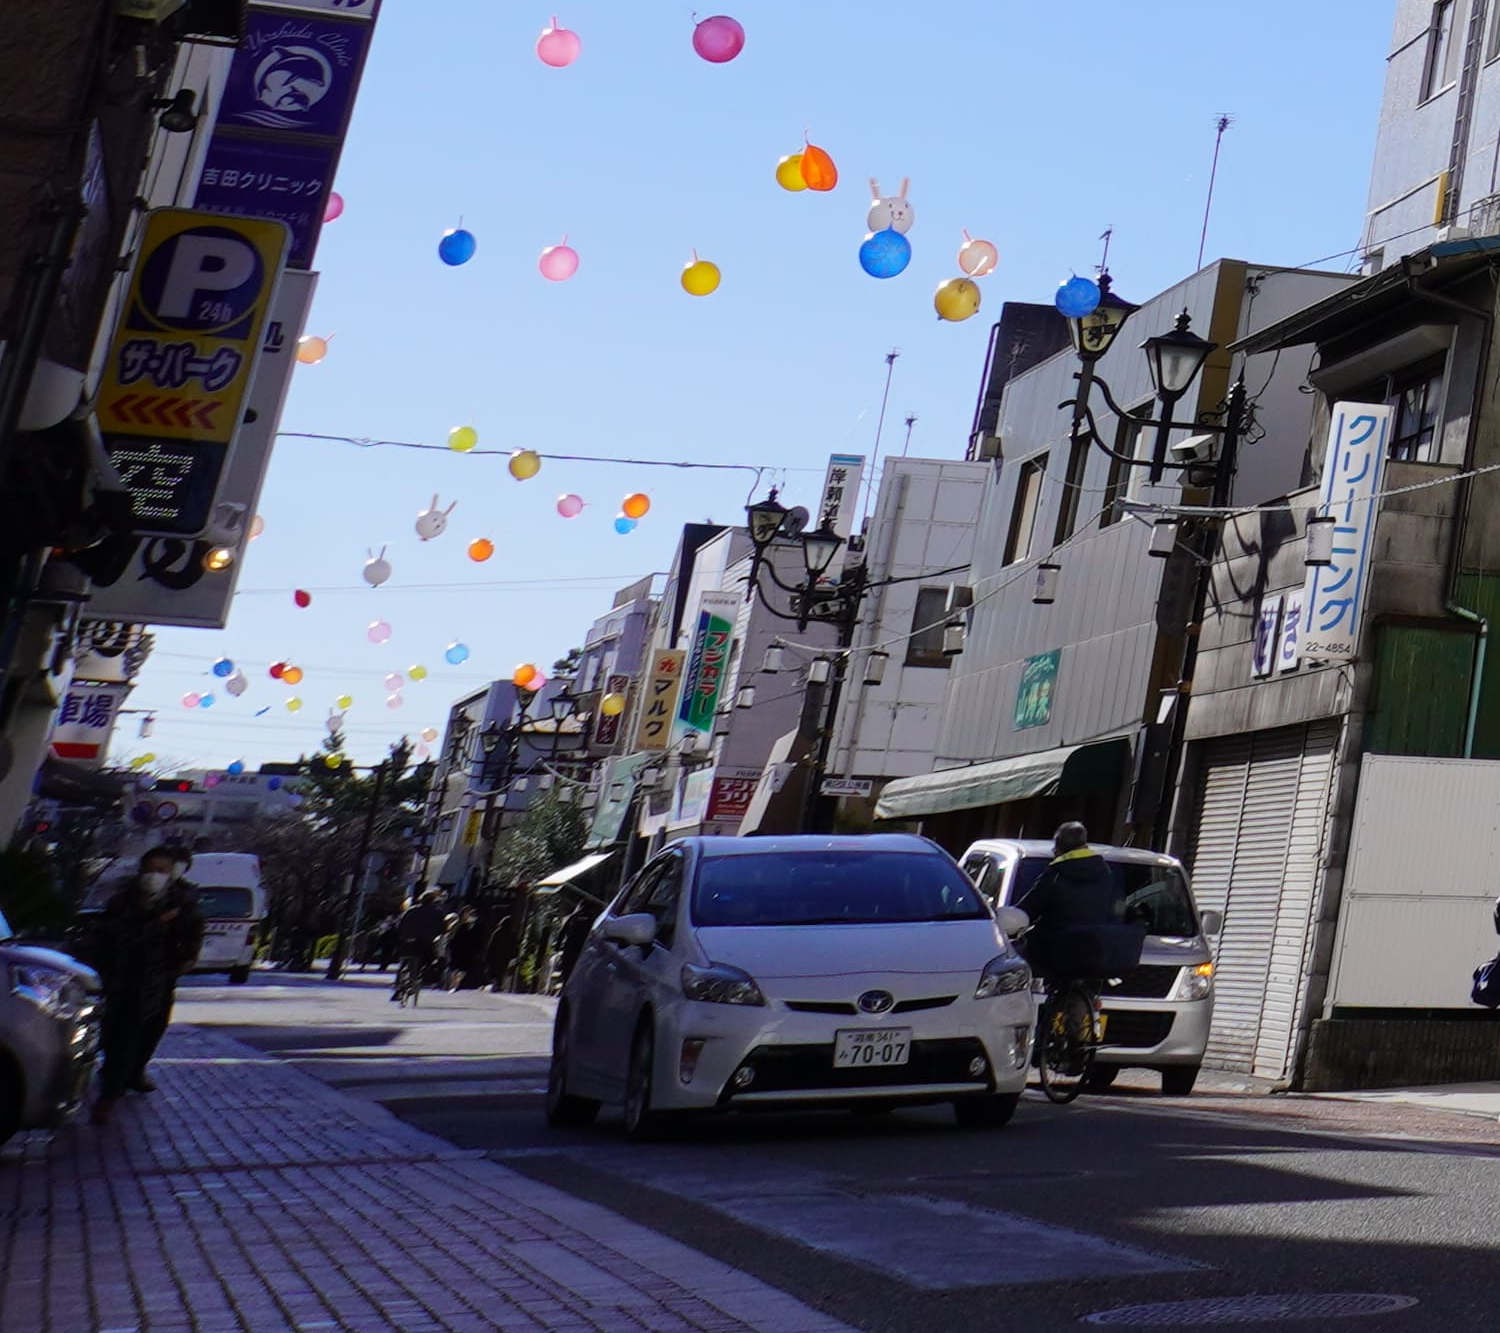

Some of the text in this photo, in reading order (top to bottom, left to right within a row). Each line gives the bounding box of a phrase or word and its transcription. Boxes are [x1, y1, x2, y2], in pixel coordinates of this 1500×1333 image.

[204, 167, 321, 196] 吉田クリニック
[157, 234, 256, 319] P
[198, 300, 233, 323] 24h
[1319, 415, 1377, 632] クリーニング
[1305, 641, 1352, 655] 22-4854
[698, 630, 729, 714] フジカラー
[645, 678, 672, 737] マルク
[851, 1043, 906, 1065] 70-07
